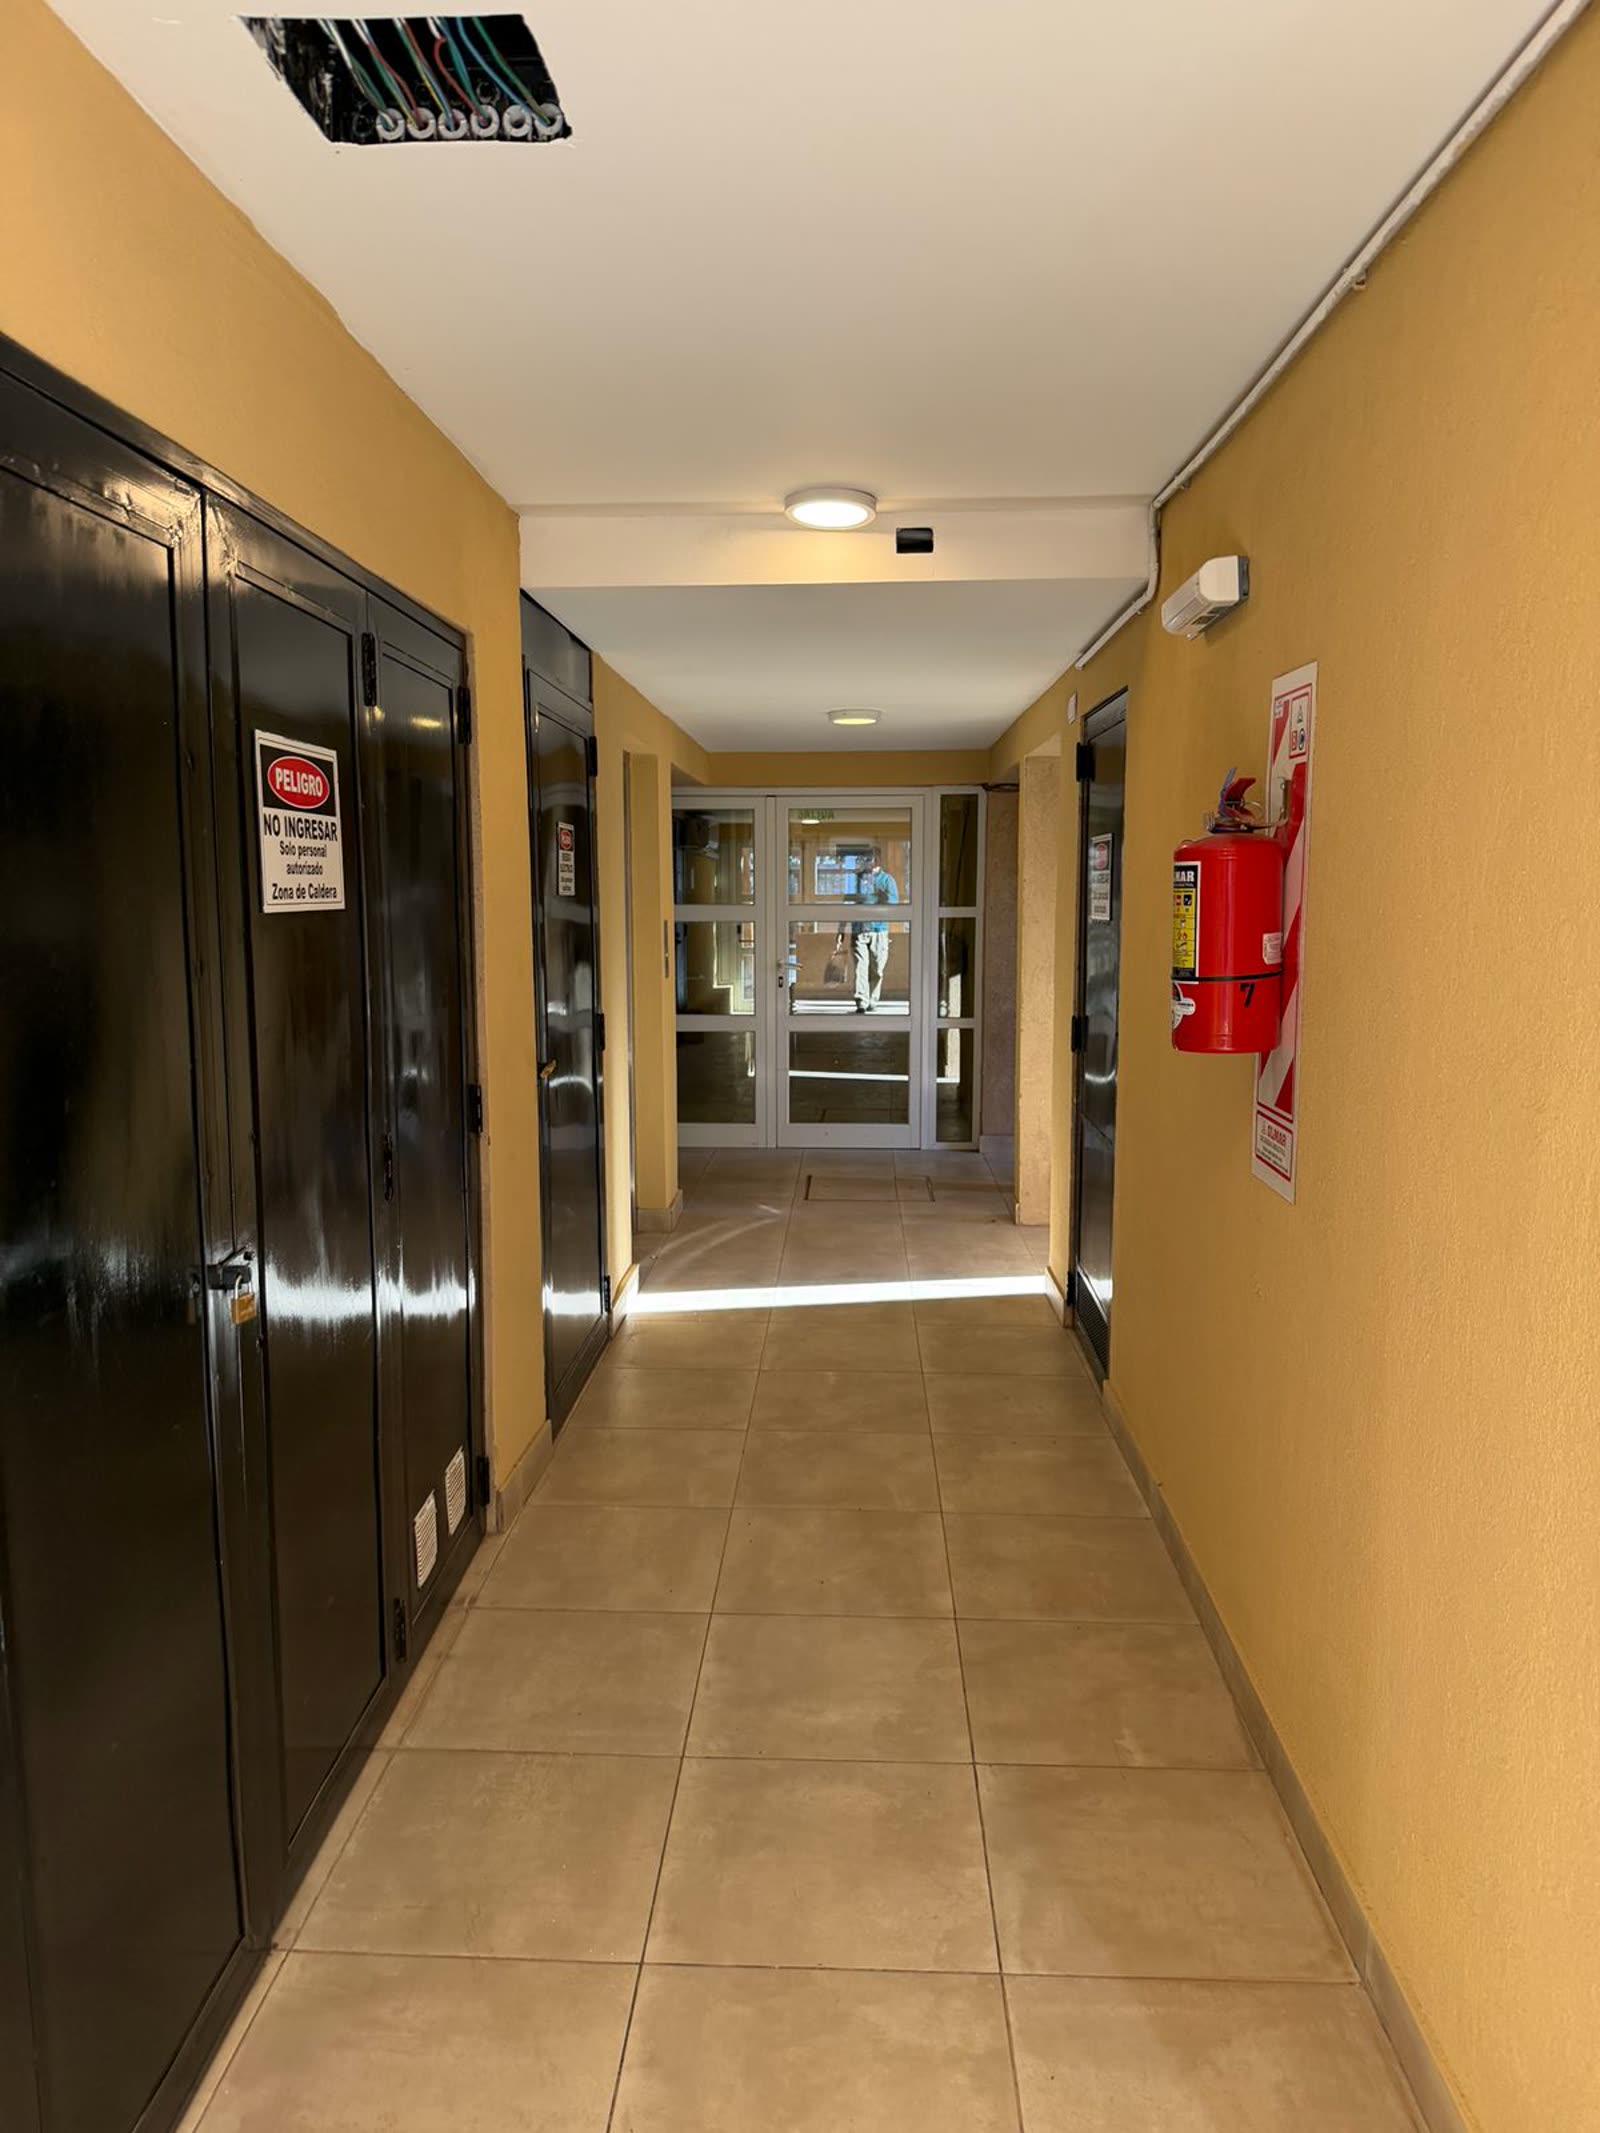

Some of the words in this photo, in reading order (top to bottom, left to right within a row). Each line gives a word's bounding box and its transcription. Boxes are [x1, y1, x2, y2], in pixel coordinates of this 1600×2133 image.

[275, 767, 324, 797] PELIGRO
[263, 813, 281, 836] NO
[284, 815, 338, 842] INGRESAR
[279, 840, 296, 856] Solo
[298, 844, 328, 860] personal
[286, 862, 324, 876] autorizado
[272, 883, 294, 900] Zona
[296, 883, 306, 900] de
[308, 883, 338, 900] Caldera
[1239, 982, 1255, 1008] 7
